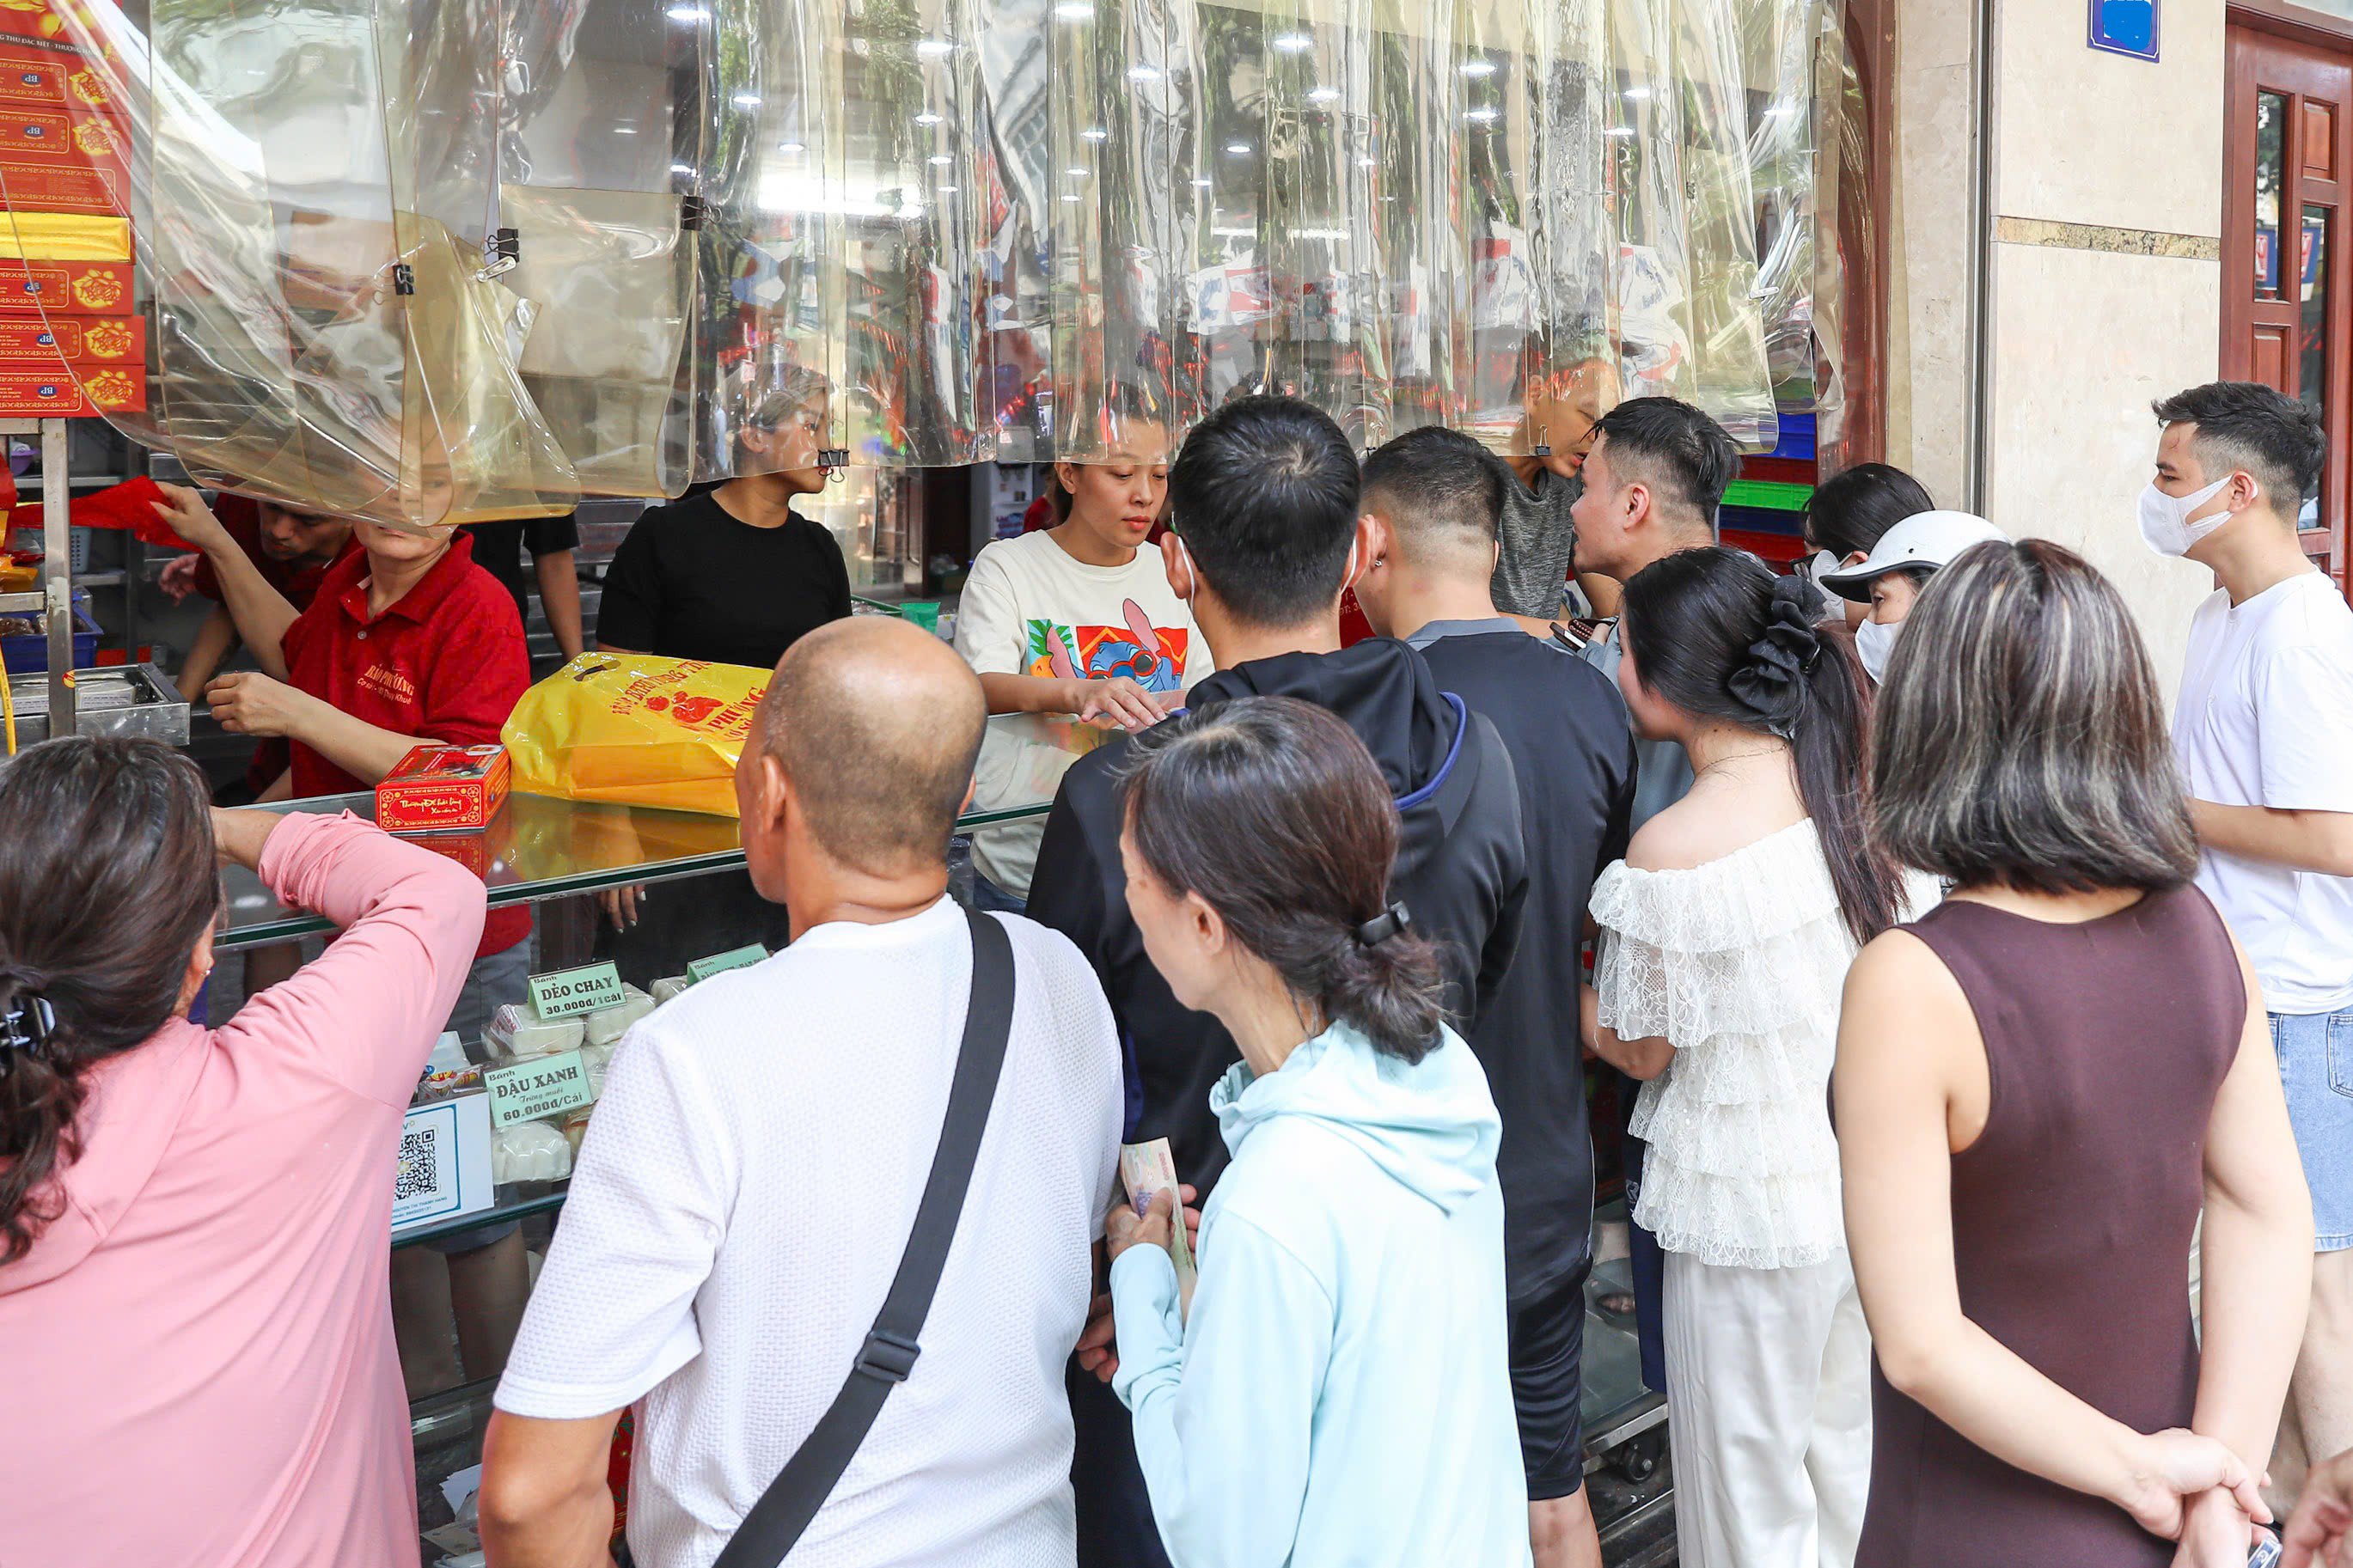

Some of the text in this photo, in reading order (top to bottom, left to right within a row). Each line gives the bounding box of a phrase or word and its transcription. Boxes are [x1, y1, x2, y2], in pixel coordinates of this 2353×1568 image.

[27, 126, 40, 135] BP
[534, 975, 558, 984] Bánh
[541, 976, 614, 1001] DẺO CHAY
[488, 1070, 516, 1082] Bánh
[495, 1065, 578, 1099] ĐẬU XANH
